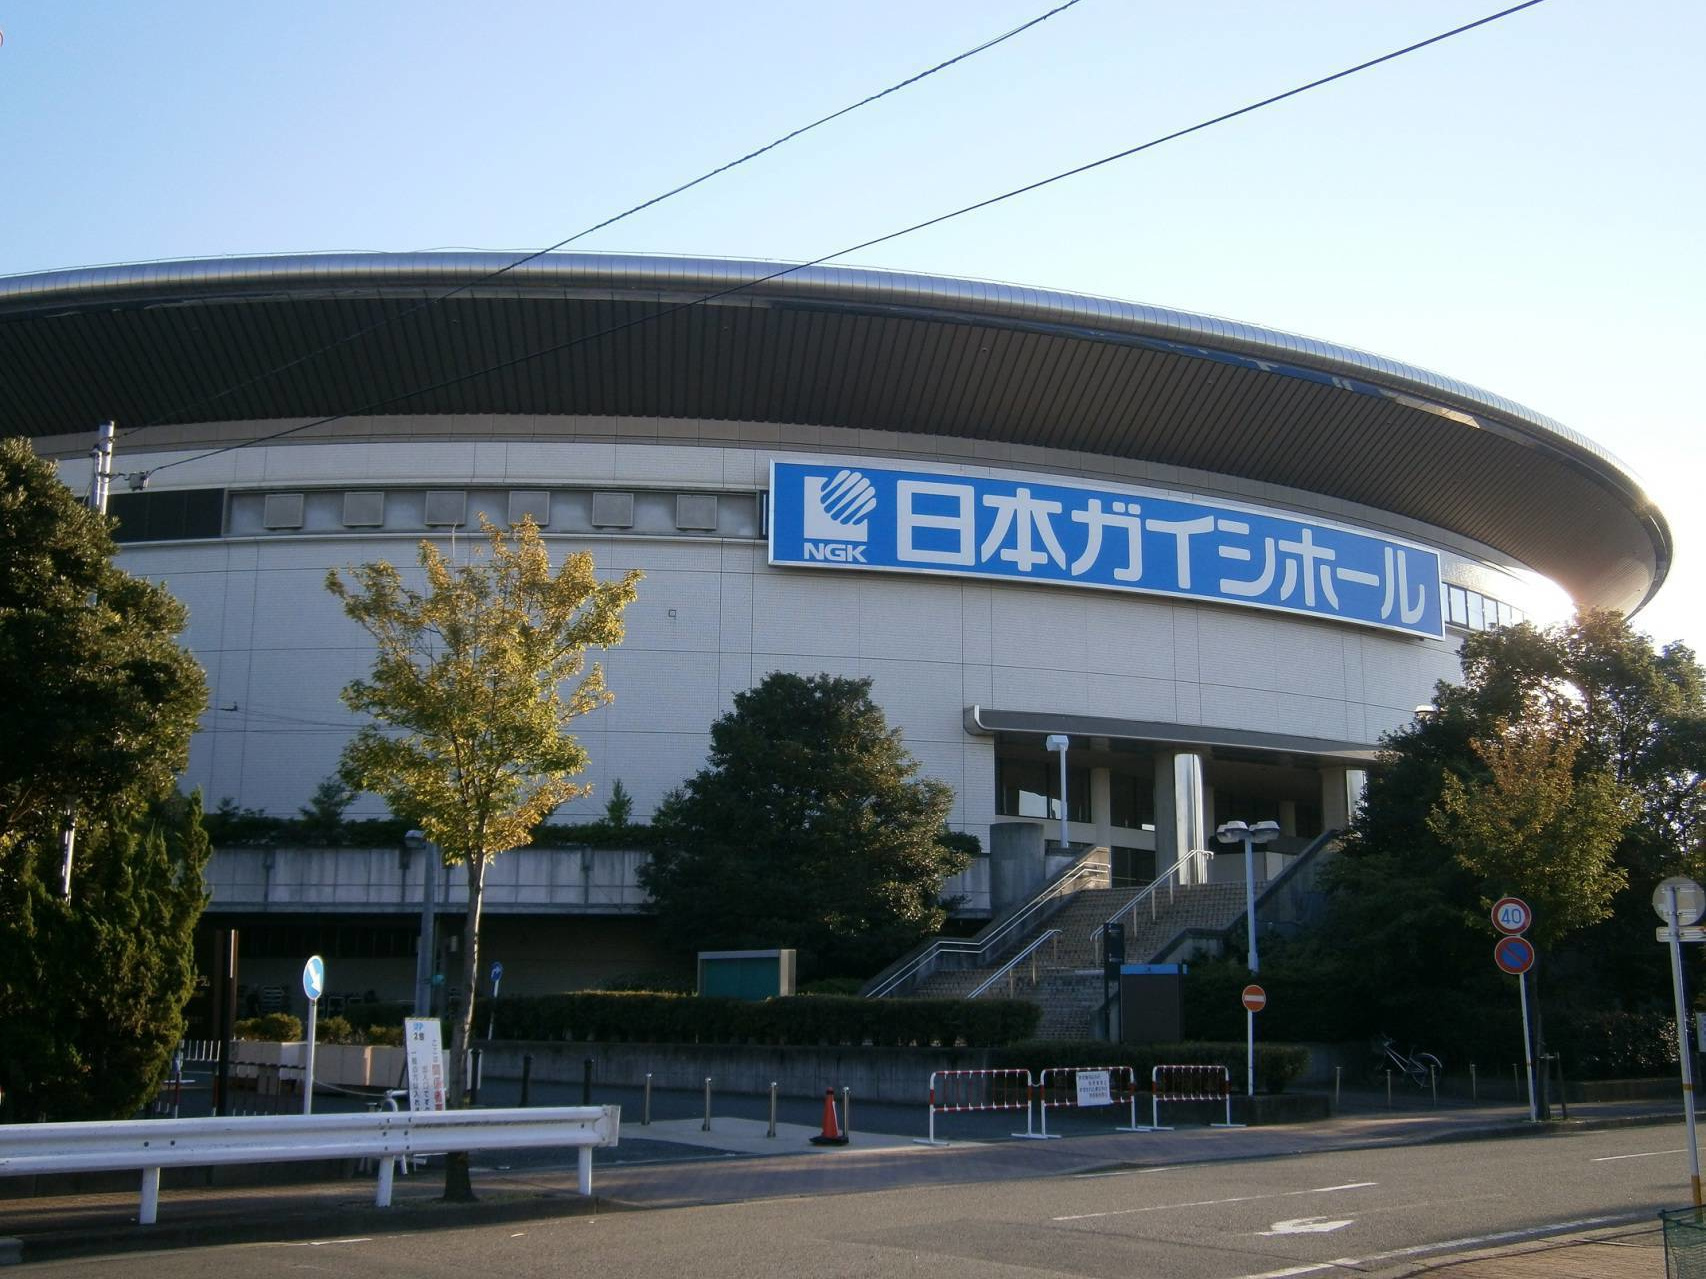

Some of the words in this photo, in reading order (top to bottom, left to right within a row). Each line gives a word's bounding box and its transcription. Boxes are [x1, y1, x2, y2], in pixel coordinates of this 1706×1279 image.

[802, 542, 868, 564] NGK
[895, 479, 1426, 624] 日本ガイシホール
[1501, 908, 1522, 925] 40
